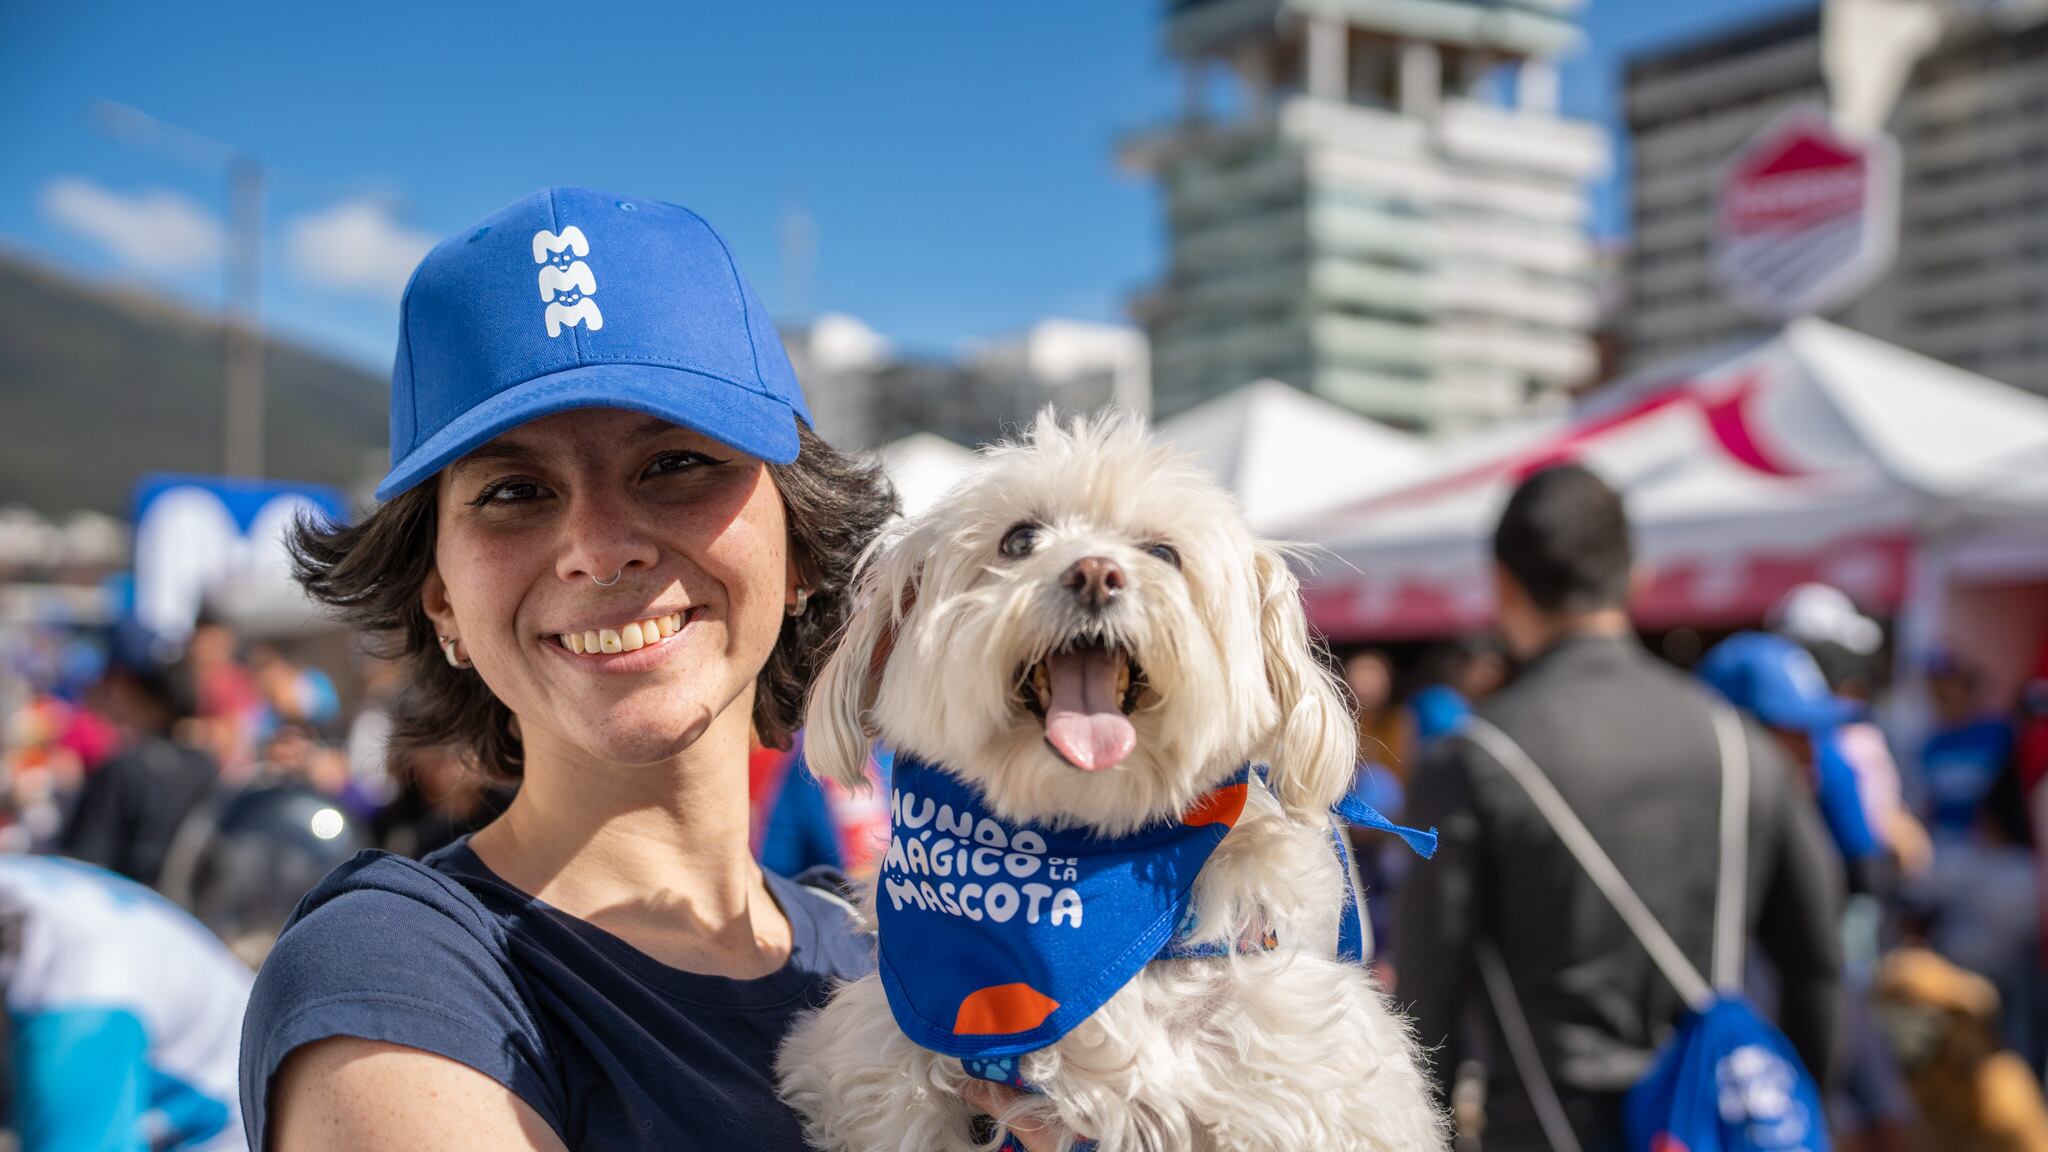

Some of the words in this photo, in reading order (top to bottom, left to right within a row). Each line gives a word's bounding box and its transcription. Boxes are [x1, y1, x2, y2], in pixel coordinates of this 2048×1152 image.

[1048, 857, 1078, 866] DE
[1049, 866, 1077, 882] LA
[885, 878, 1083, 928] MASCOTA
